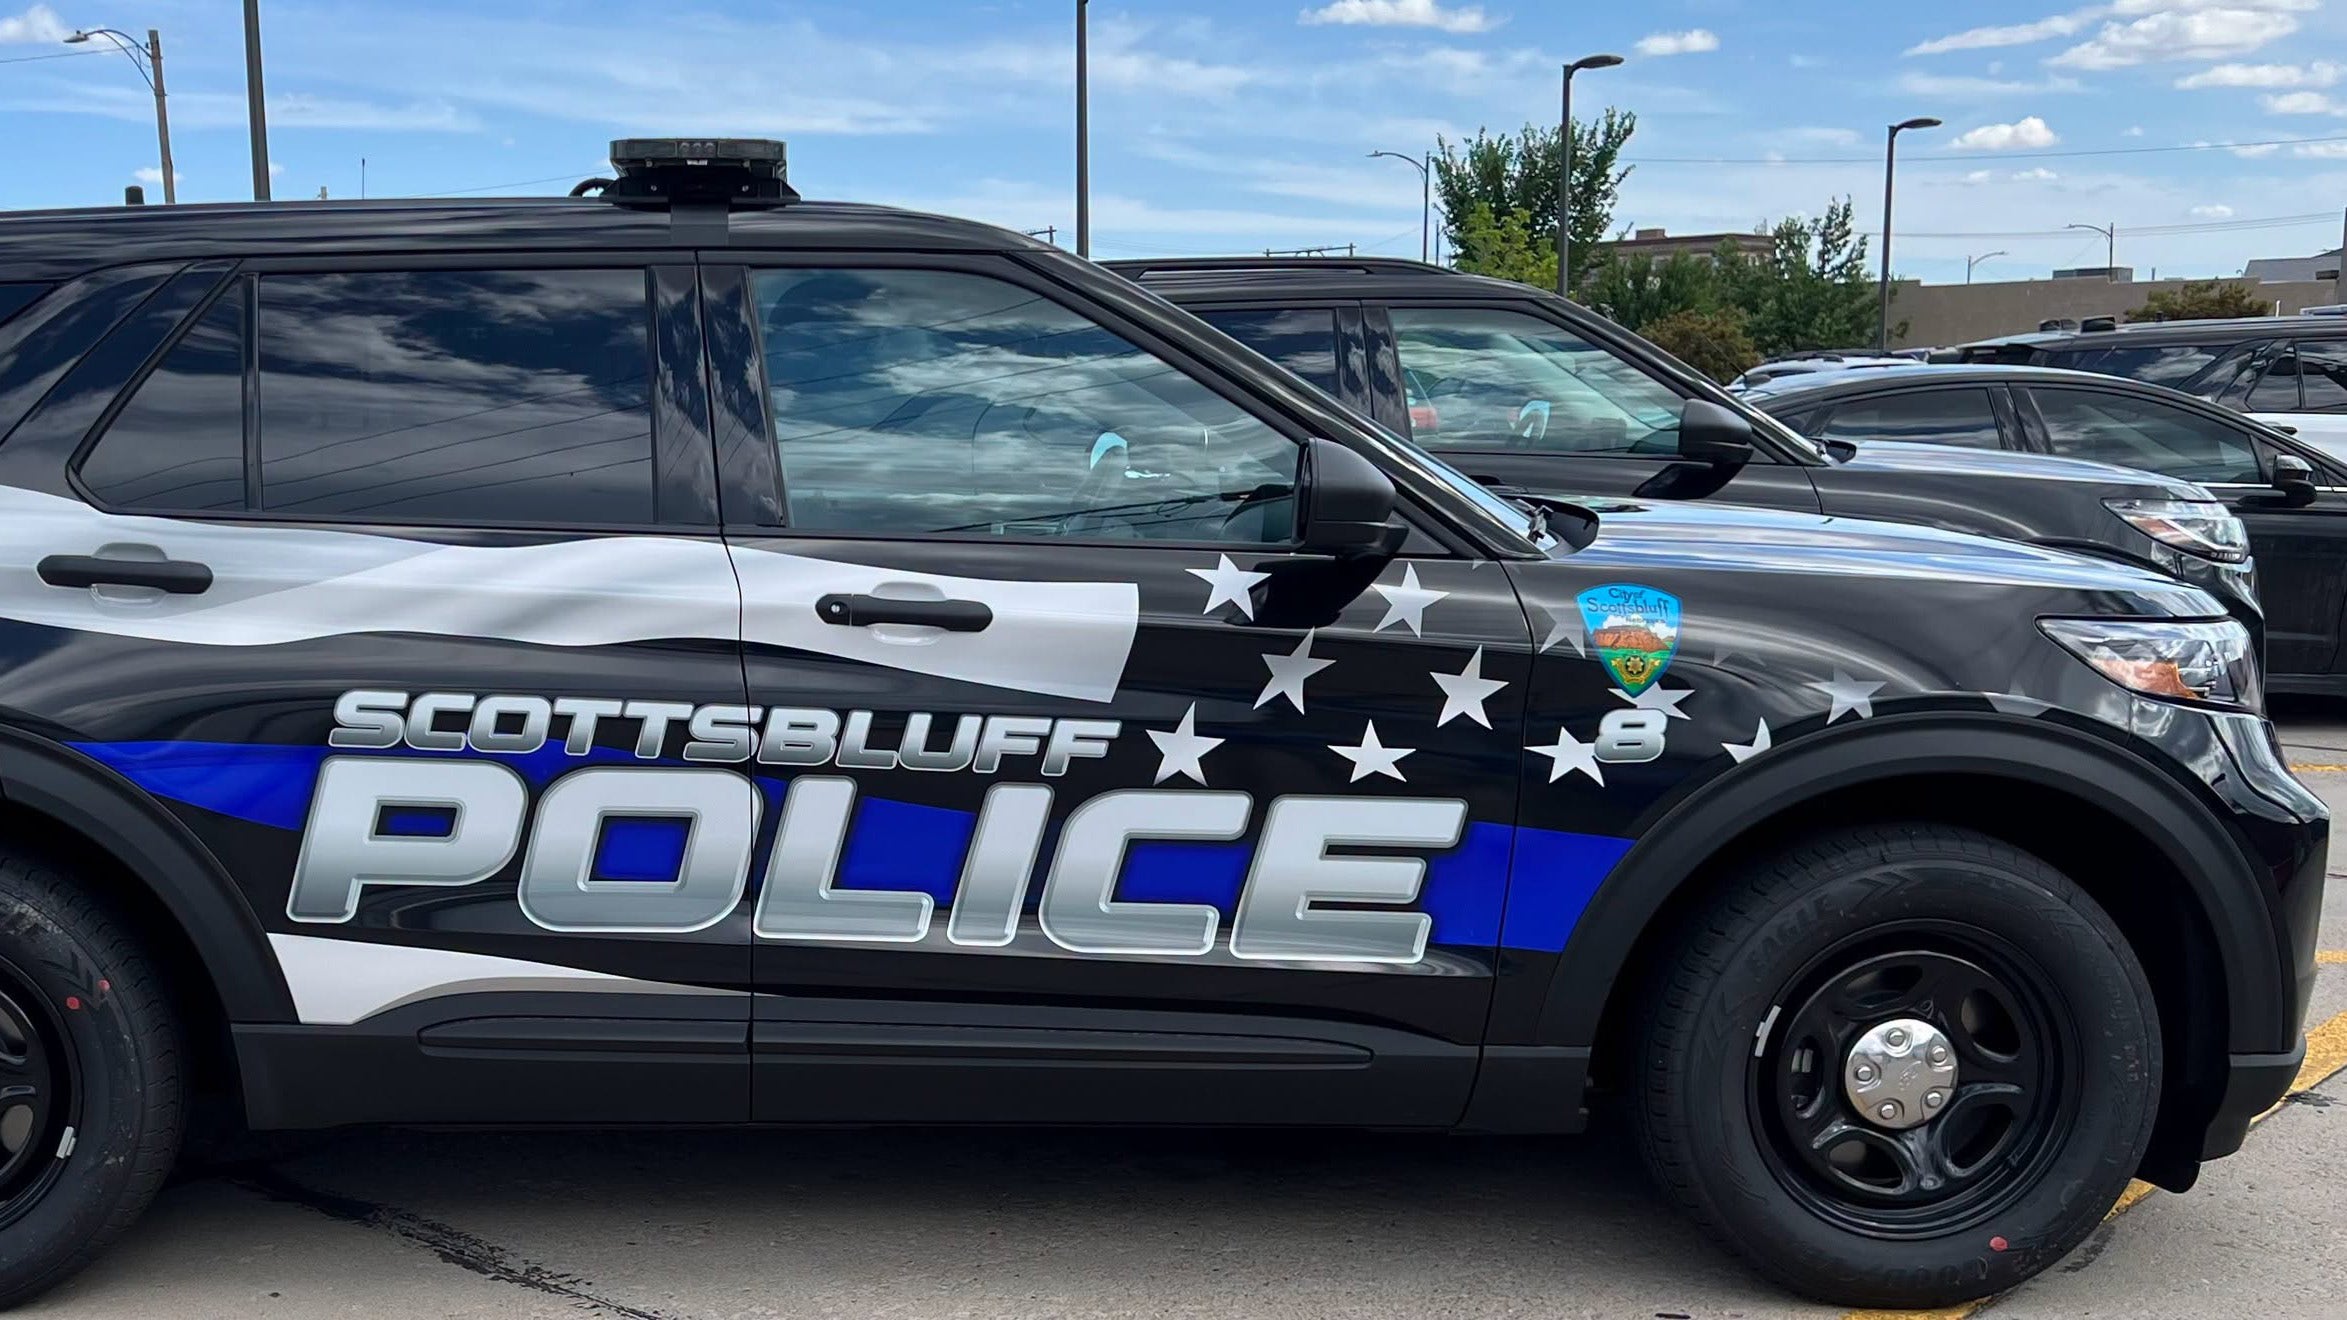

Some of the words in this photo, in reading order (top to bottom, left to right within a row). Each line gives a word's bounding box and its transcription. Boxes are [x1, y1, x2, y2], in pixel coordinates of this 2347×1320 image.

[1587, 597, 1670, 617] Scottsbluff
[1608, 588, 1634, 602] City
[328, 690, 1122, 776] SCOTTSBLUFF
[1595, 708, 1668, 763] 8
[285, 755, 1469, 965] POLICE
